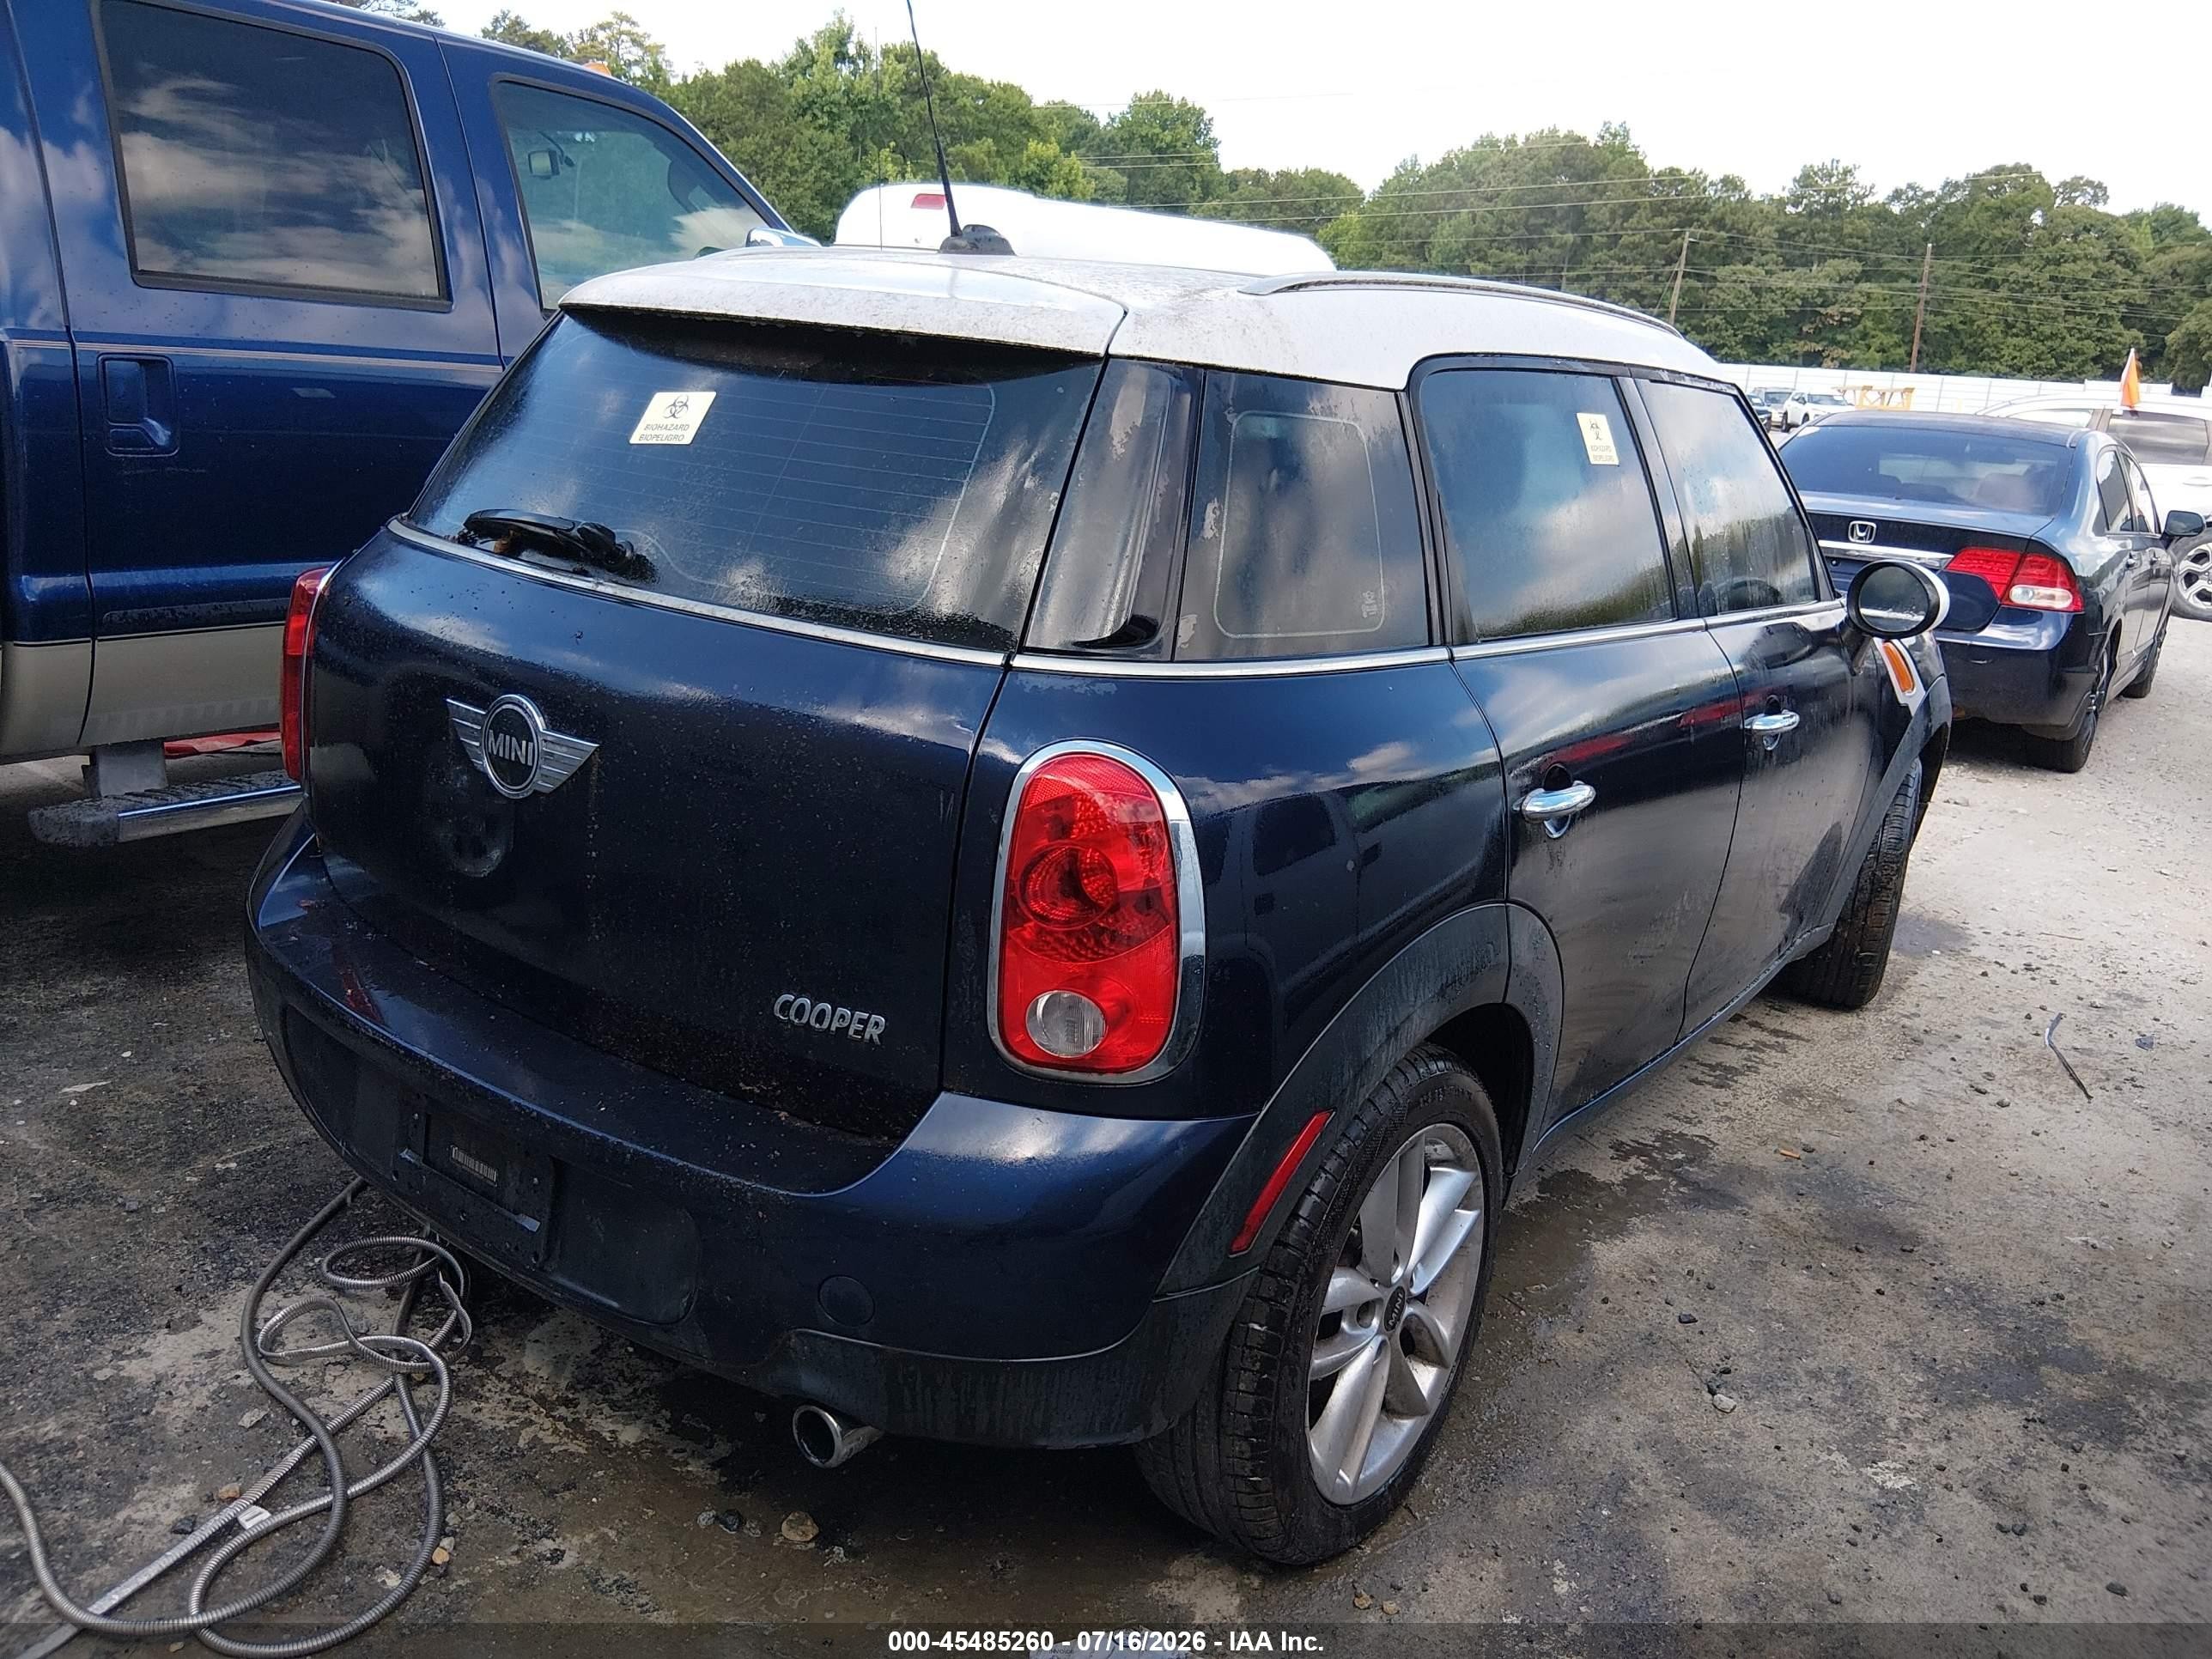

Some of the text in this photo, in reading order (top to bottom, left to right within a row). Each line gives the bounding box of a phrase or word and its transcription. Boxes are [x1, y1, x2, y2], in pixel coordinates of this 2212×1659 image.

[488, 730, 534, 766] MINI
[774, 994, 885, 1045] COOPER
[1389, 1293, 1403, 1326] MINI
